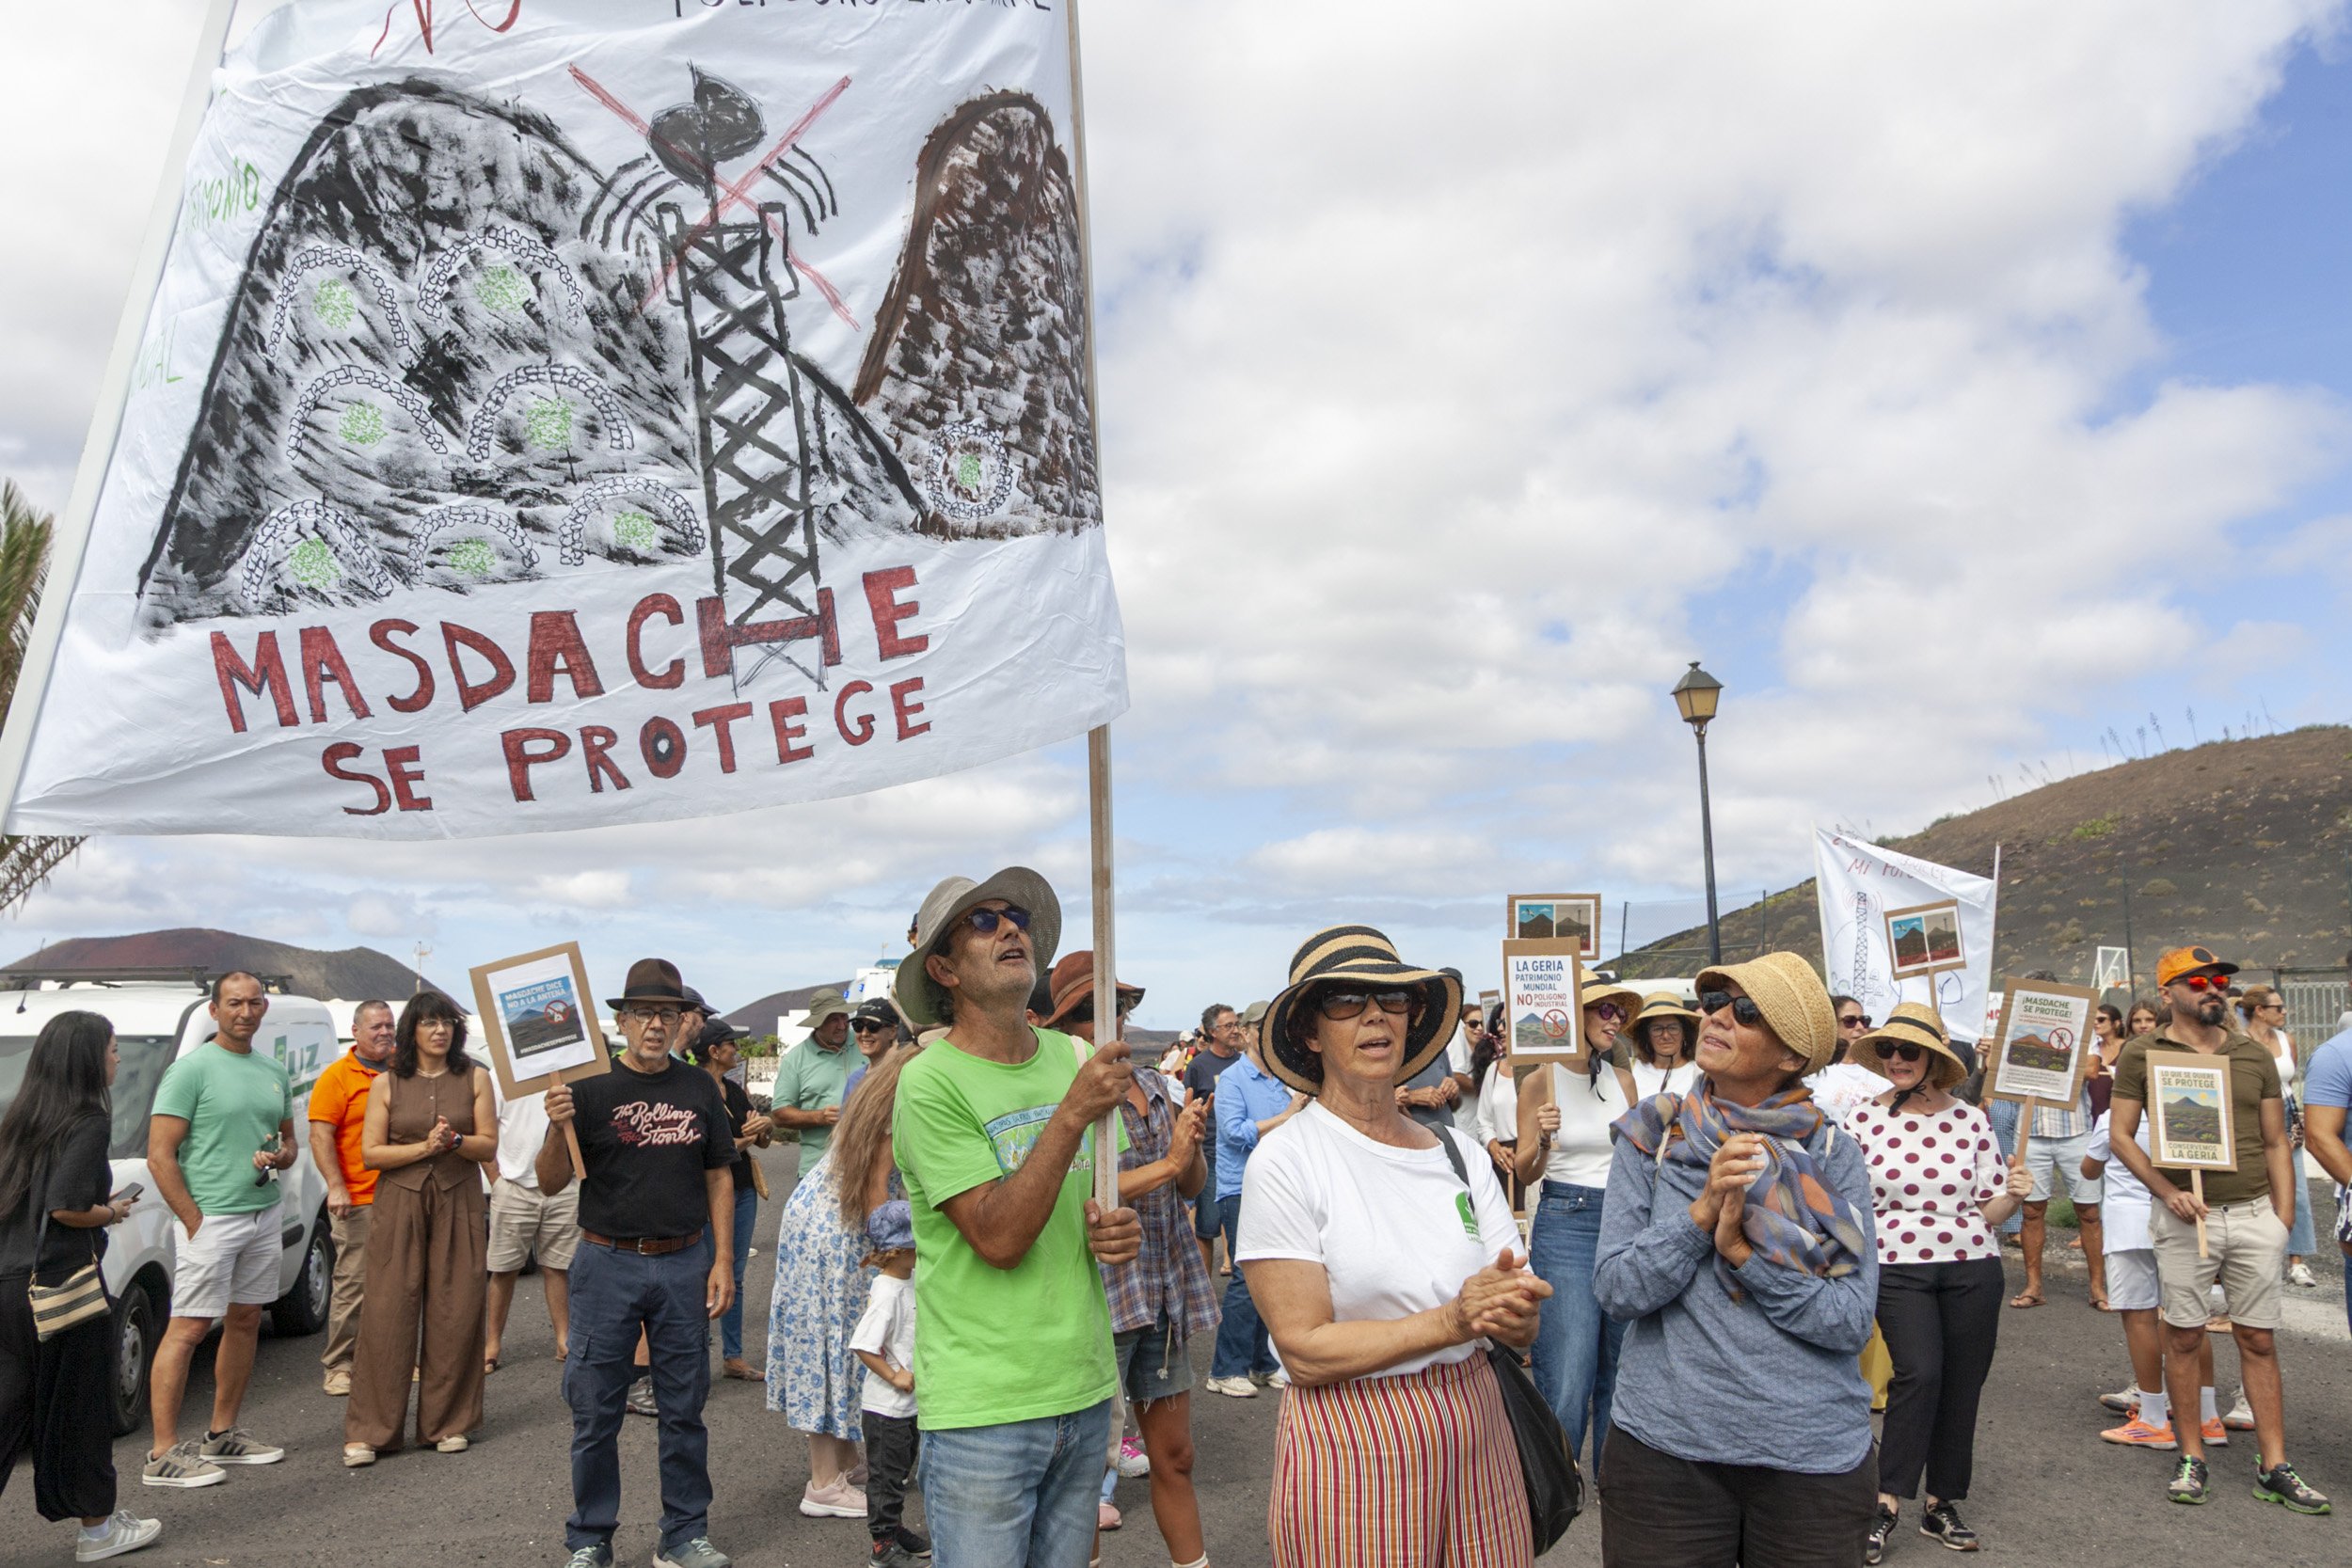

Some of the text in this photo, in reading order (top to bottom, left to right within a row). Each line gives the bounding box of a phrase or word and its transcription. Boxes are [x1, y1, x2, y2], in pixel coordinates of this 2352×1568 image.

[210, 565, 932, 734] MASDACHE
[322, 676, 932, 816] SE PROTEGE
[1517, 960, 1564, 972] LA GERIA
[505, 980, 563, 1001] MASDACHE DICE
[508, 999, 518, 1008] NO
[527, 995, 536, 1005] LA
[537, 989, 565, 1002] ANTENA
[1517, 994, 1533, 1006] NO
[2022, 996, 2070, 1009] ¡MASDACHE
[2023, 1005, 2073, 1019] SE PROTEGE!
[2162, 1077, 2215, 1088] SE PROTEGE
[630, 1101, 697, 1132] Rolling
[637, 1123, 702, 1148] Stones
[2168, 1142, 2217, 1151] CONSERVEMOS
[2171, 1149, 2217, 1161] LA GERIA
